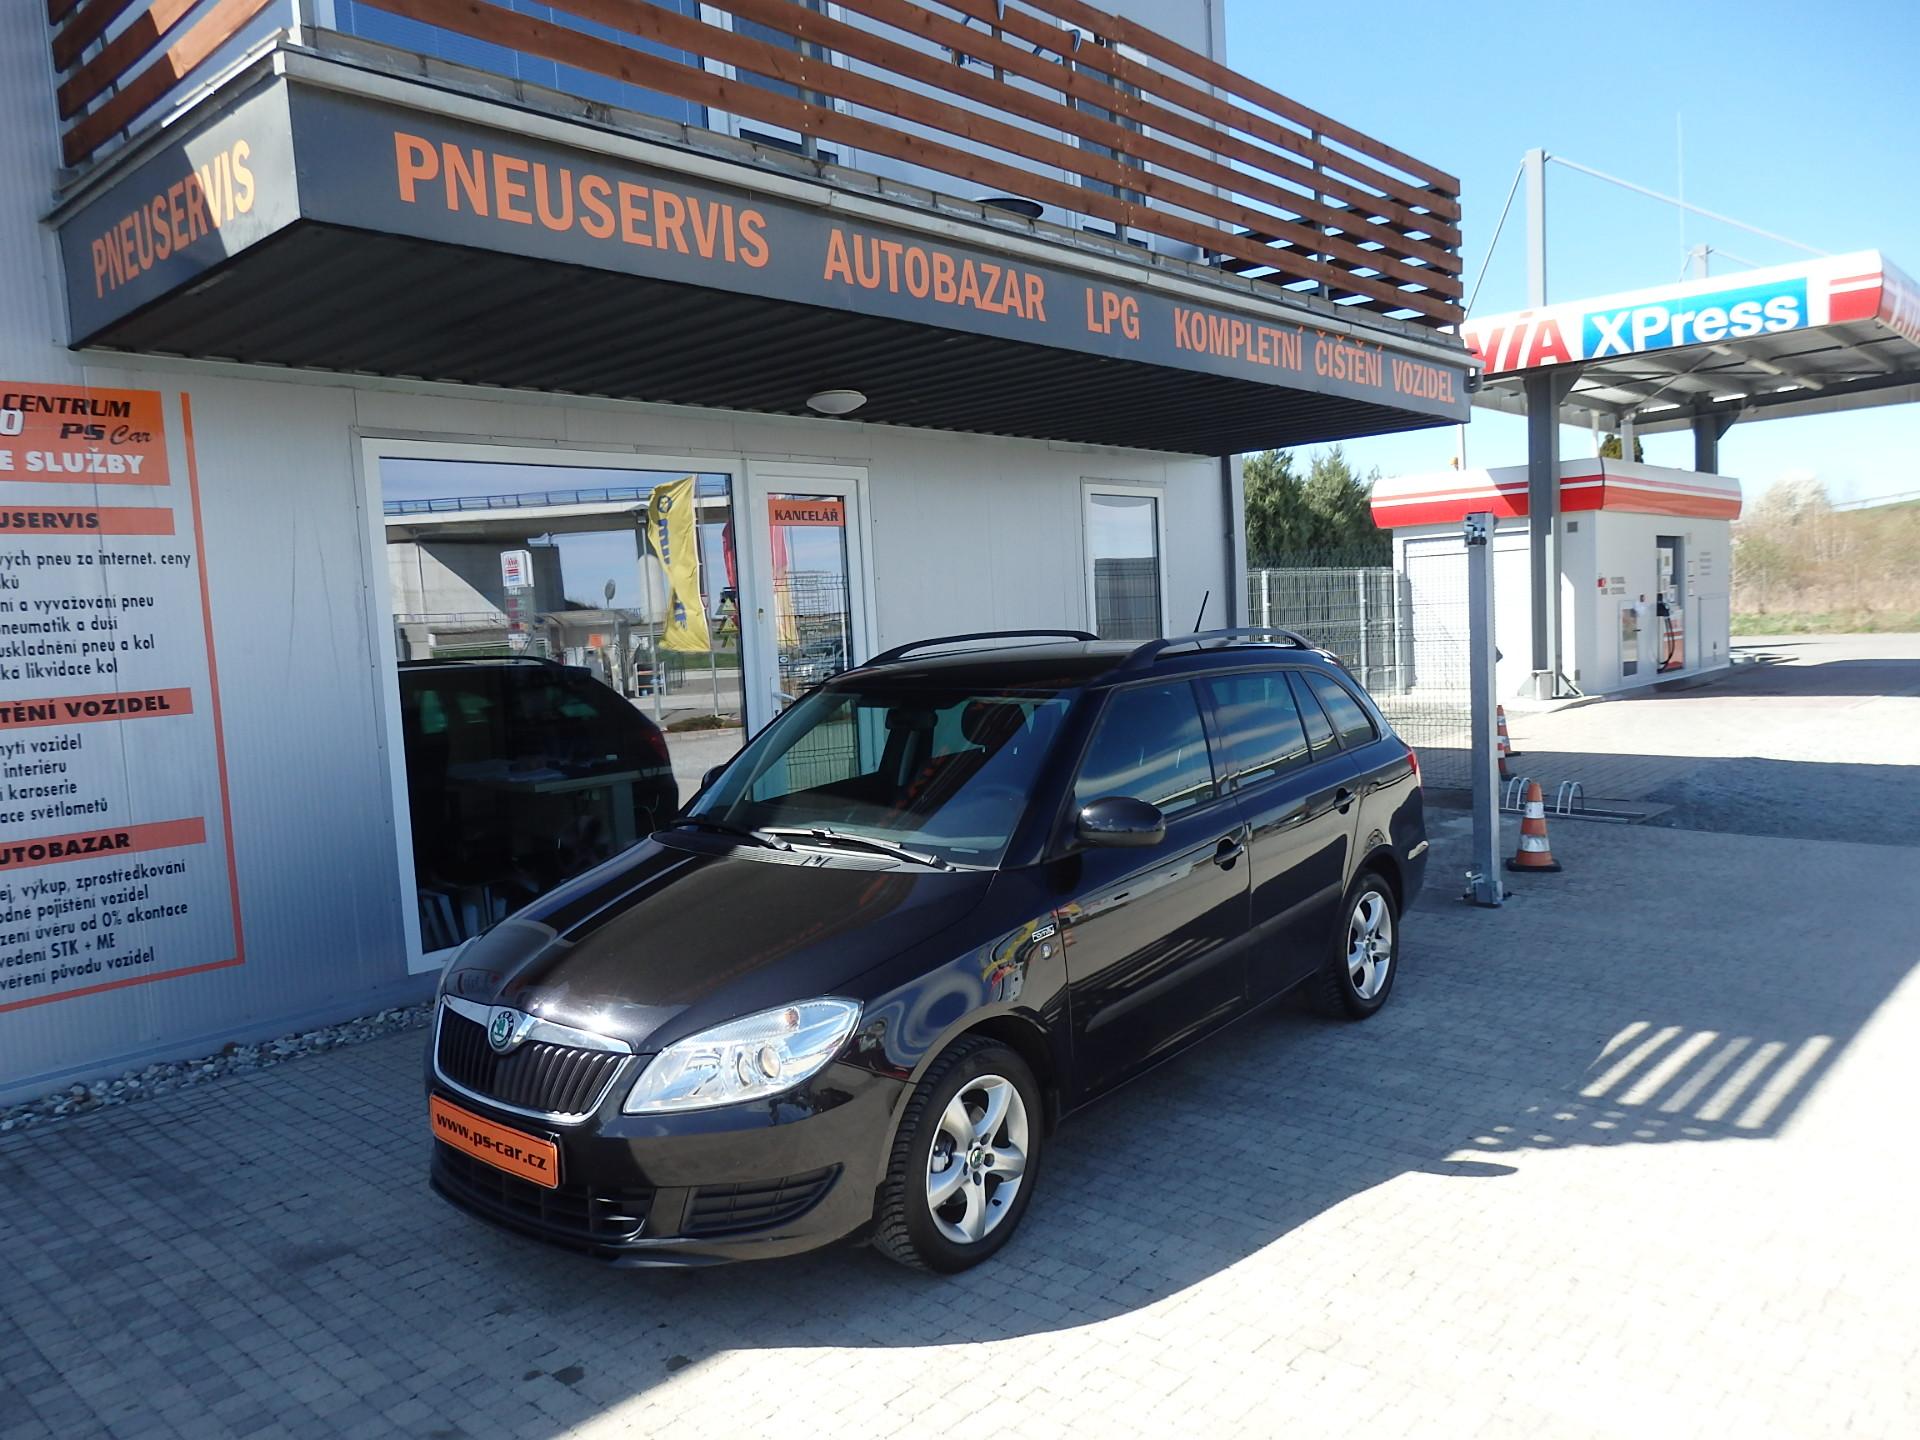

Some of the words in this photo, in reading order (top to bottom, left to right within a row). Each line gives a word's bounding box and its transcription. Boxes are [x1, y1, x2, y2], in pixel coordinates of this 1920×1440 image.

[92, 139, 255, 299] PNEUSERVIS
[394, 131, 769, 268] PNEUSERVIS
[824, 228, 1047, 322] AUTOBAZAR
[1086, 287, 1140, 340] LPG
[1174, 307, 1305, 371] KOMPLETNÍ
[1314, 329, 1385, 387] ČIŠTĚNÍ
[1392, 358, 1456, 403] VOZIDEL
[1590, 296, 1799, 358] XPress
[3, 394, 130, 418] CENTRUM
[60, 423, 107, 441] PS
[110, 424, 152, 445] Car
[25, 447, 145, 475] SLUŽBY
[774, 508, 839, 522] KANCELÁŘ
[37, 554, 72, 570] pneu
[76, 554, 93, 566] za
[98, 549, 157, 566] internet.
[161, 553, 191, 568] ceny
[20, 600, 28, 612] a
[34, 594, 117, 615] vyvažování
[121, 596, 154, 612] pneu
[77, 621, 85, 631] a
[82, 640, 116, 658] pneu
[121, 640, 129, 651] a
[133, 633, 155, 650] kol
[25, 659, 91, 680] likvidace
[96, 657, 118, 674] kol
[64, 695, 170, 718] VOZIDEL
[30, 733, 82, 754] vozidel
[4, 759, 67, 778] interiéru
[8, 779, 77, 800] karoserie
[31, 798, 109, 821] světlometů
[21, 878, 71, 900] výkup,
[76, 859, 186, 892] zprostředkování
[37, 893, 96, 922] pojištění
[101, 884, 149, 907] vozidel
[35, 923, 76, 941] úvěru
[80, 914, 97, 932] od
[102, 910, 122, 928] 0%
[127, 903, 188, 924] akontace
[51, 939, 79, 960] STK
[51, 958, 102, 985] původu
[107, 946, 155, 970] vozidel
[436, 1112, 548, 1171] www.ps-car.cz
